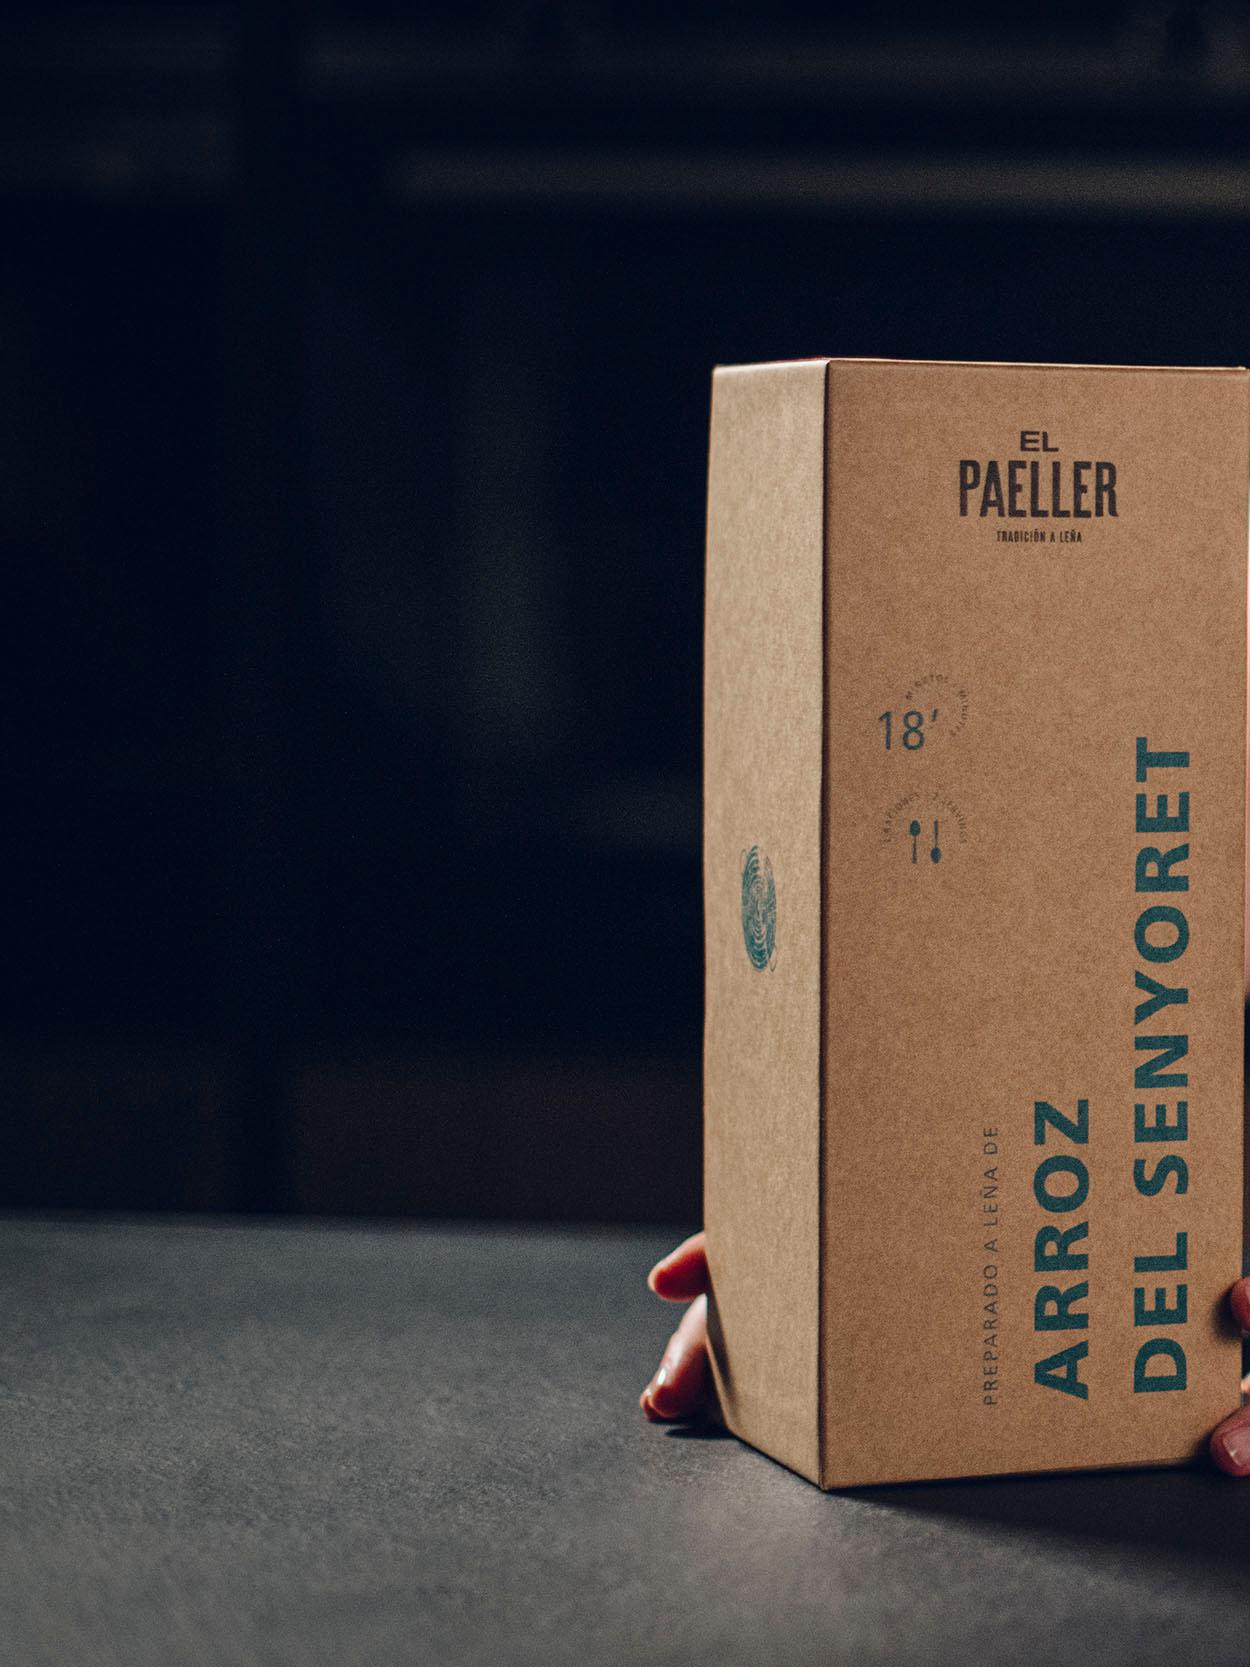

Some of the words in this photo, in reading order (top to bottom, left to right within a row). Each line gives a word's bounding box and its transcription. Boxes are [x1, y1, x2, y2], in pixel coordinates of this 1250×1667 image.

[1020, 430, 1060, 452] EL
[959, 460, 1119, 518] PAELLER
[997, 528, 1046, 543] TRADICIÓN
[1050, 531, 1056, 543] A
[1060, 529, 1082, 543] LEÑA
[1133, 736, 1190, 1197] SENYORET
[983, 1127, 998, 1155] DE
[980, 1167, 998, 1227] LEÑA
[983, 1238, 998, 1253] A
[1033, 1099, 1089, 1401] ARROZ
[983, 1264, 998, 1406] PREPARADO
[1133, 1231, 1188, 1394] DEL
